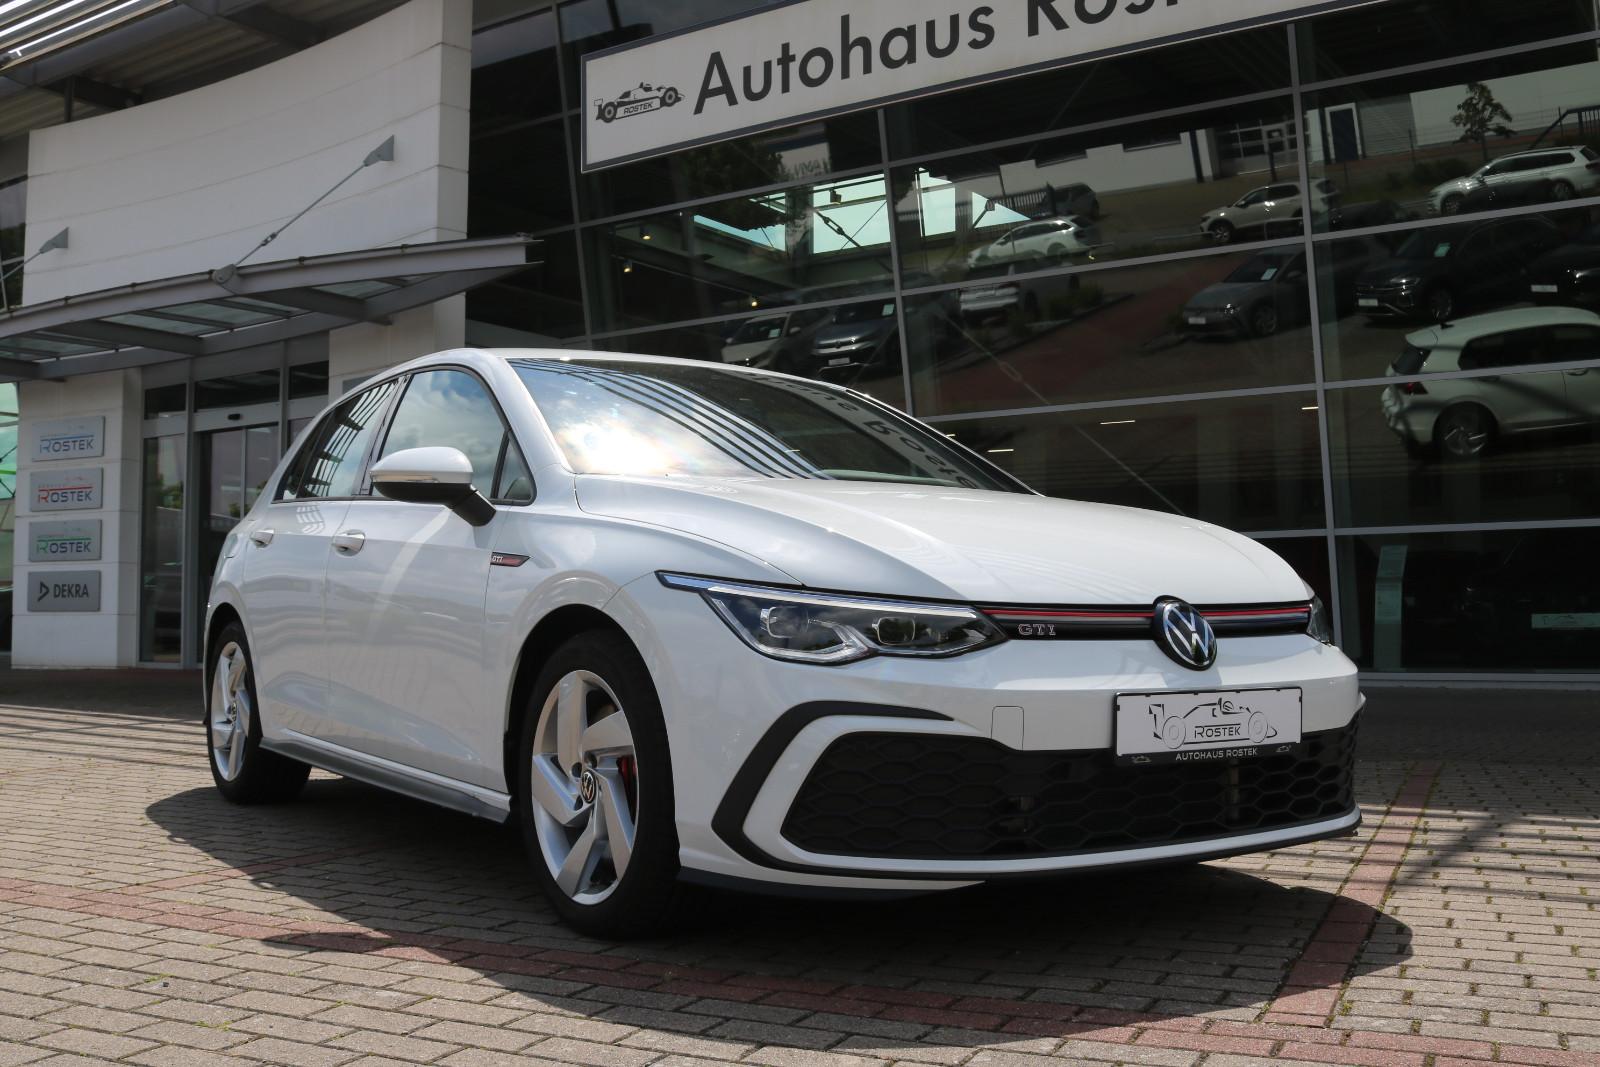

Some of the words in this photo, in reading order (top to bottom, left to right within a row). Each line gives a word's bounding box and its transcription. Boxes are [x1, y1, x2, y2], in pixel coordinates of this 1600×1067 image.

[693, 6, 996, 116] Autohaus
[624, 102, 653, 115] ROSTEK
[40, 437, 94, 453] ROSTEK
[38, 488, 92, 503] ROSTEK
[36, 539, 91, 554] ROSTEK
[53, 583, 89, 598] DEKRA
[1018, 623, 1057, 636] GTI
[1194, 725, 1241, 739] ROSTEK
[1176, 750, 1224, 761] AUTOHAUS
[1226, 747, 1258, 758] ROSTEK
